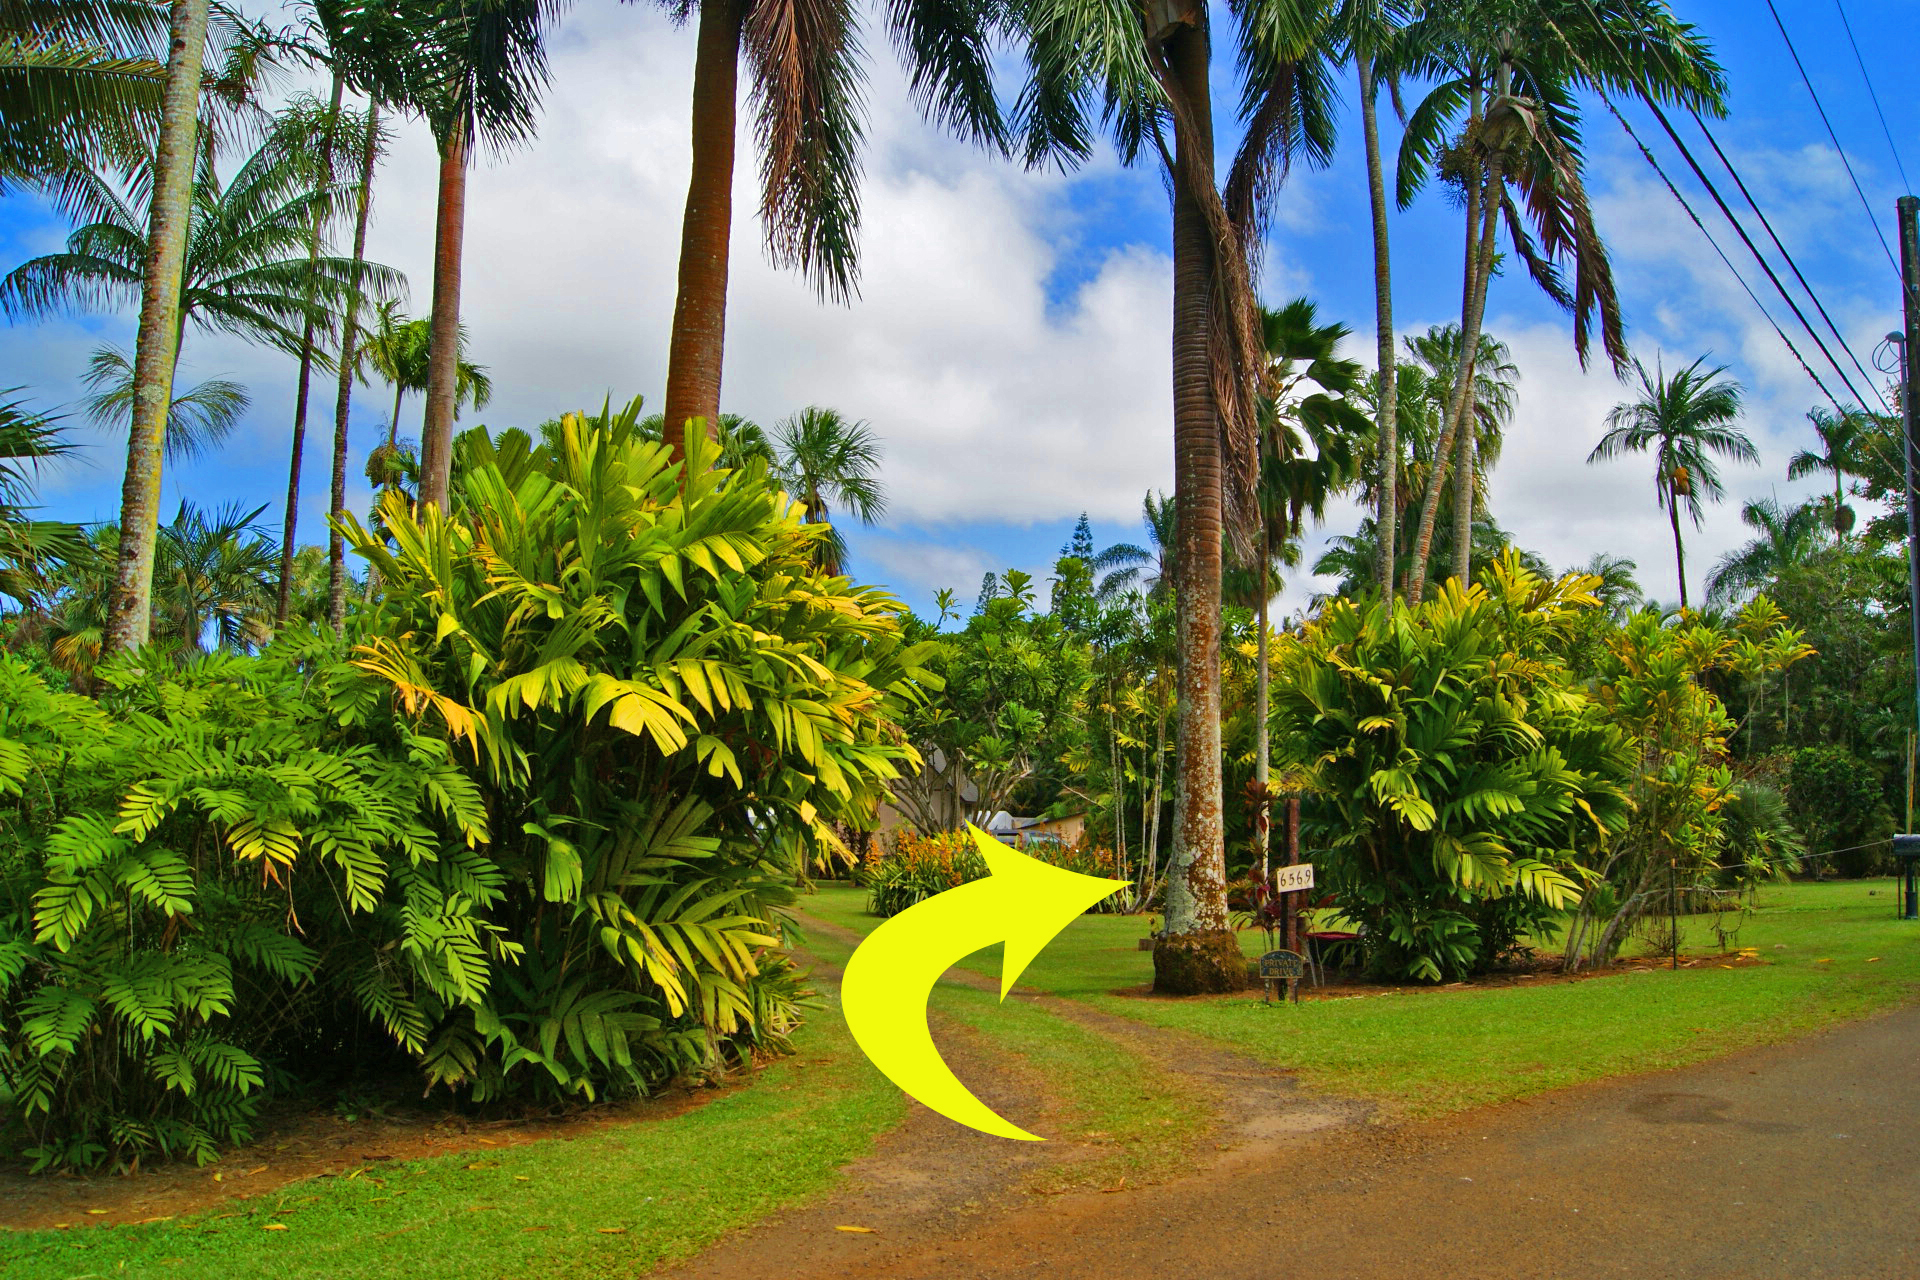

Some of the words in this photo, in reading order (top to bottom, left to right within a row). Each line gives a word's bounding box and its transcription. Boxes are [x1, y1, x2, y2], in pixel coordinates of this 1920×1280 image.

[1280, 869, 1311, 886] 6569
[1264, 959, 1298, 967] PRIVATE
[1269, 967, 1293, 975] DRIVE
